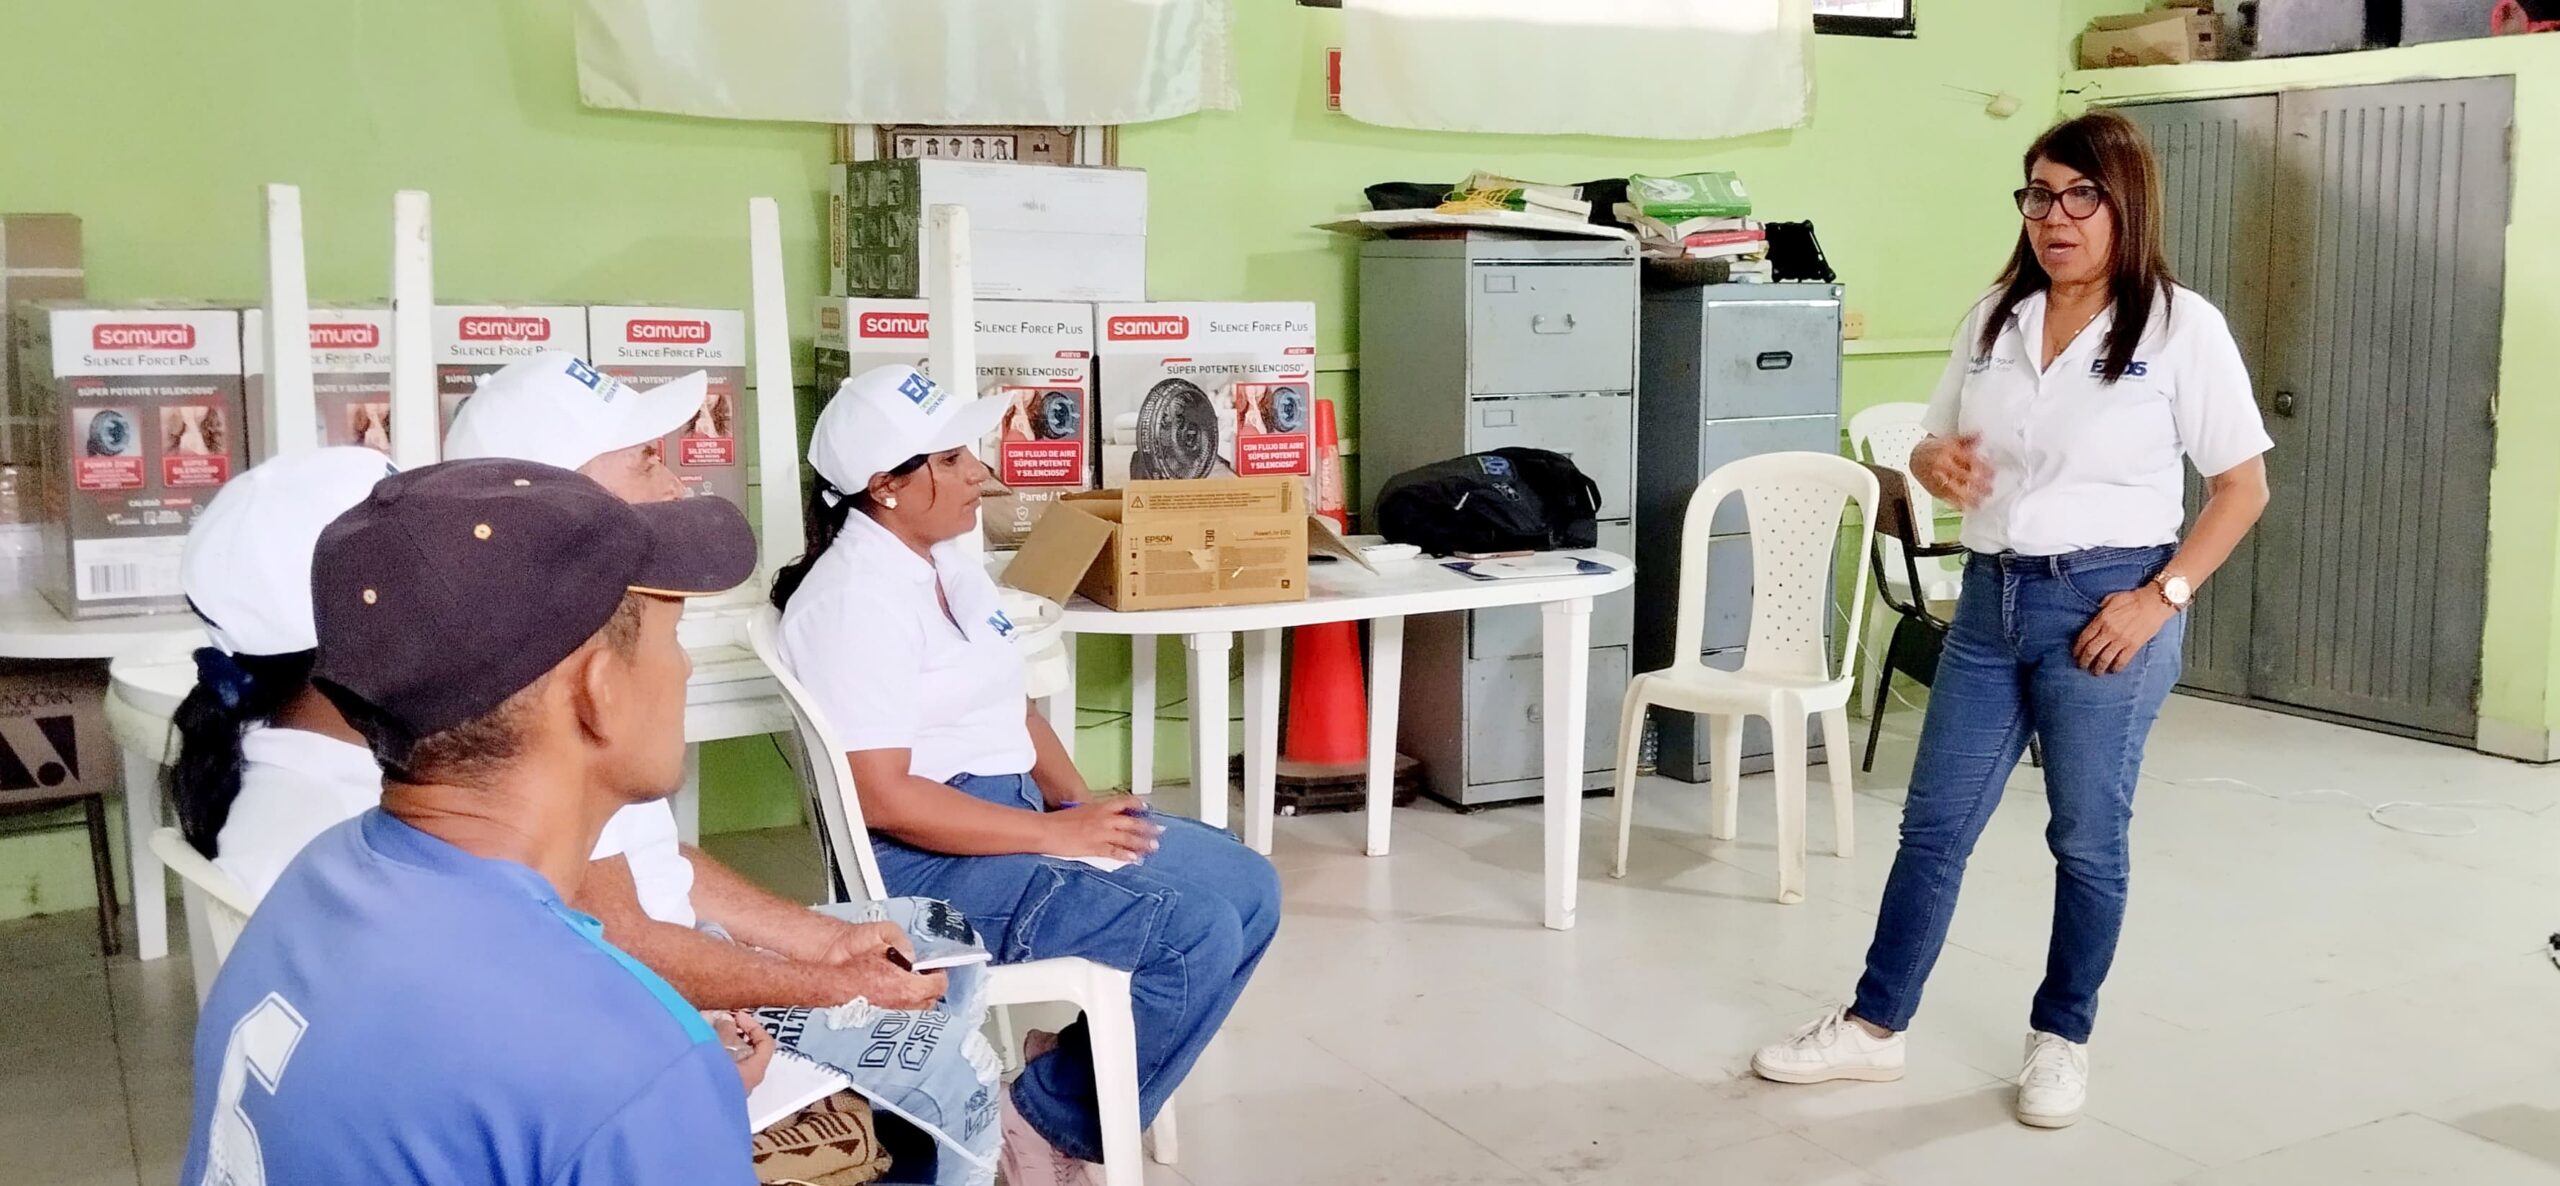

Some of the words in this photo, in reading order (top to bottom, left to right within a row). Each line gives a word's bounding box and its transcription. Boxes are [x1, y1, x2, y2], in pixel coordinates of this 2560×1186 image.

[465, 317, 544, 336] samurai
[632, 321, 705, 339] samurai
[866, 318, 928, 333] samur
[1114, 316, 1184, 336] samurai
[100, 325, 188, 344] samurai
[1008, 367, 1014, 376] Y
[1167, 364, 1197, 375] SÚPER
[1199, 365, 1240, 374] POTENTE
[1242, 364, 1247, 373] Y
[110, 386, 151, 396] POTENTE
[153, 386, 159, 395] Y
[1008, 450, 1023, 458] CON
[1025, 450, 1047, 458] FLUJO
[1048, 450, 1058, 458] DE
[1059, 450, 1077, 458] AIRE
[1013, 458, 1038, 468] SÚPER
[1039, 459, 1072, 467] POTENTE
[1016, 469, 1022, 477] Y
[1019, 491, 1047, 502] Pared
[1144, 535, 1173, 543] EPSON
